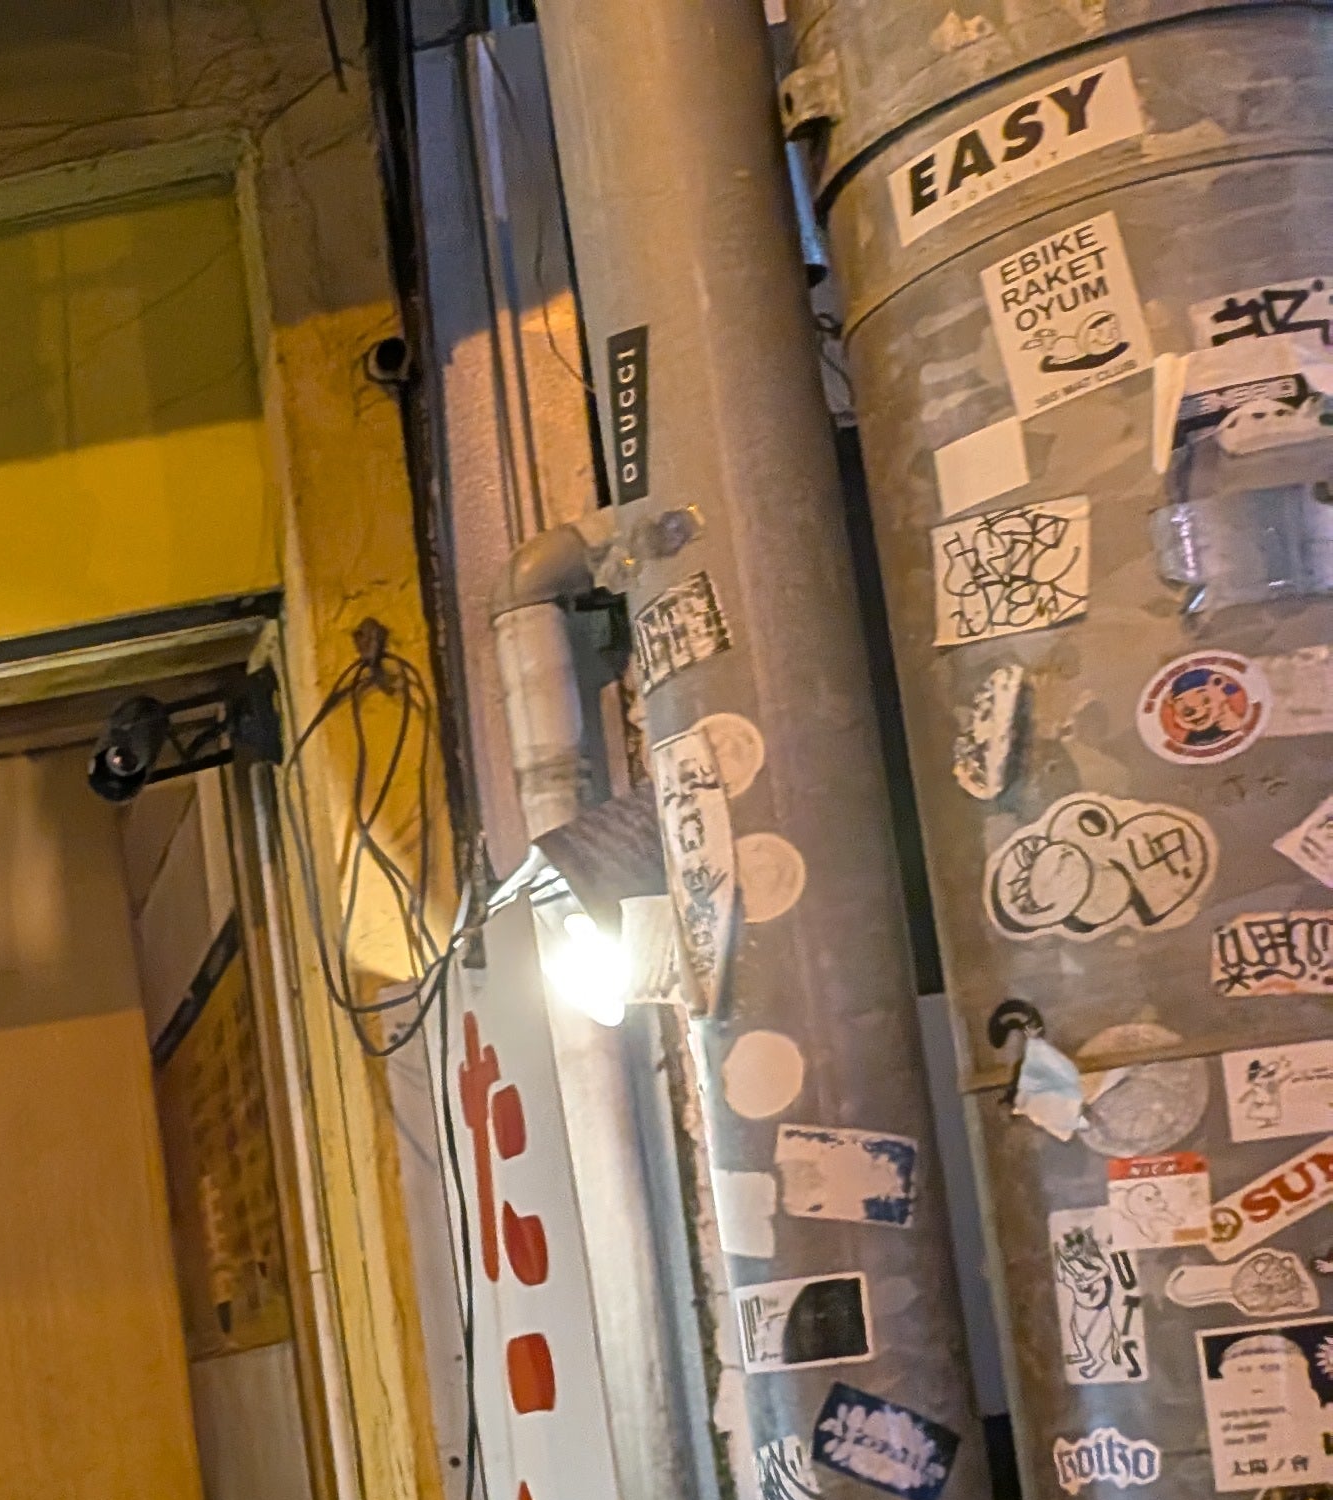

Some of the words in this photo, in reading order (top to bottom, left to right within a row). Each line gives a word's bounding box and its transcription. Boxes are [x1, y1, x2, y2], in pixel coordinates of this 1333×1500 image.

[909, 72, 1104, 216] EASY
[1000, 225, 1098, 285] EBIKE
[1001, 246, 1107, 313] RAKET
[1015, 276, 1109, 331] OYUM
[1108, 1233, 1142, 1378] UTS
